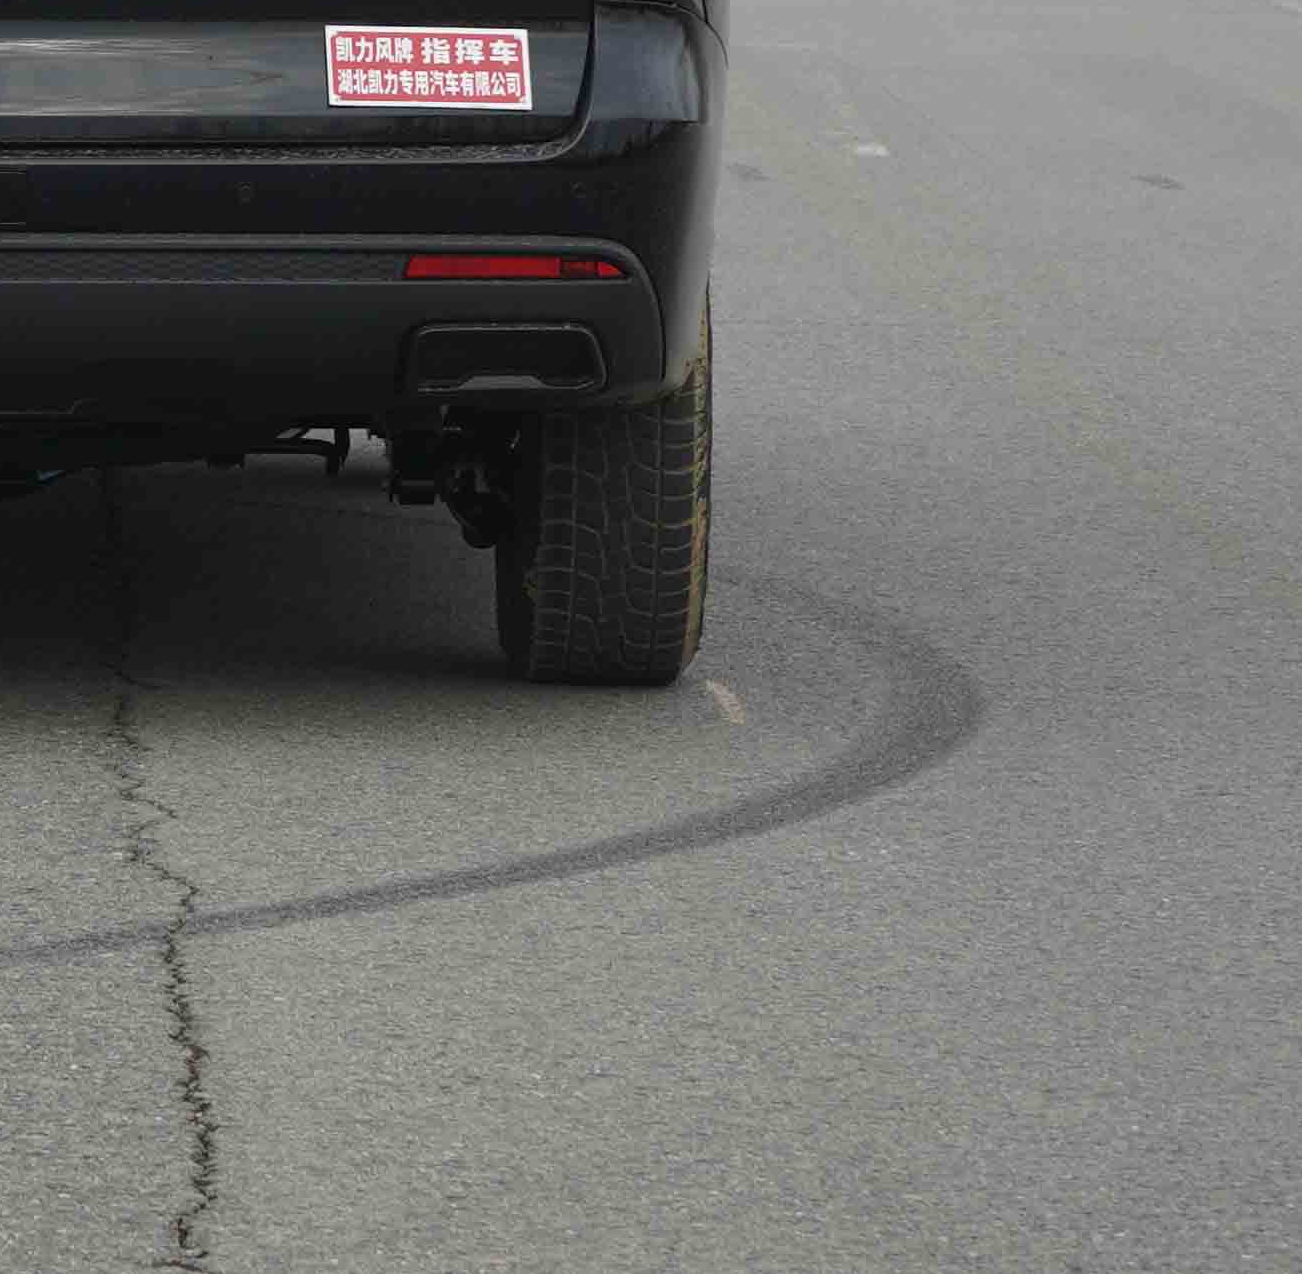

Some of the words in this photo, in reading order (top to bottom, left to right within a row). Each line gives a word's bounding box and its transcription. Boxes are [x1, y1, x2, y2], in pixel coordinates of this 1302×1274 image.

[337, 68, 521, 97] 湖北凯力专用汽车有限公司
